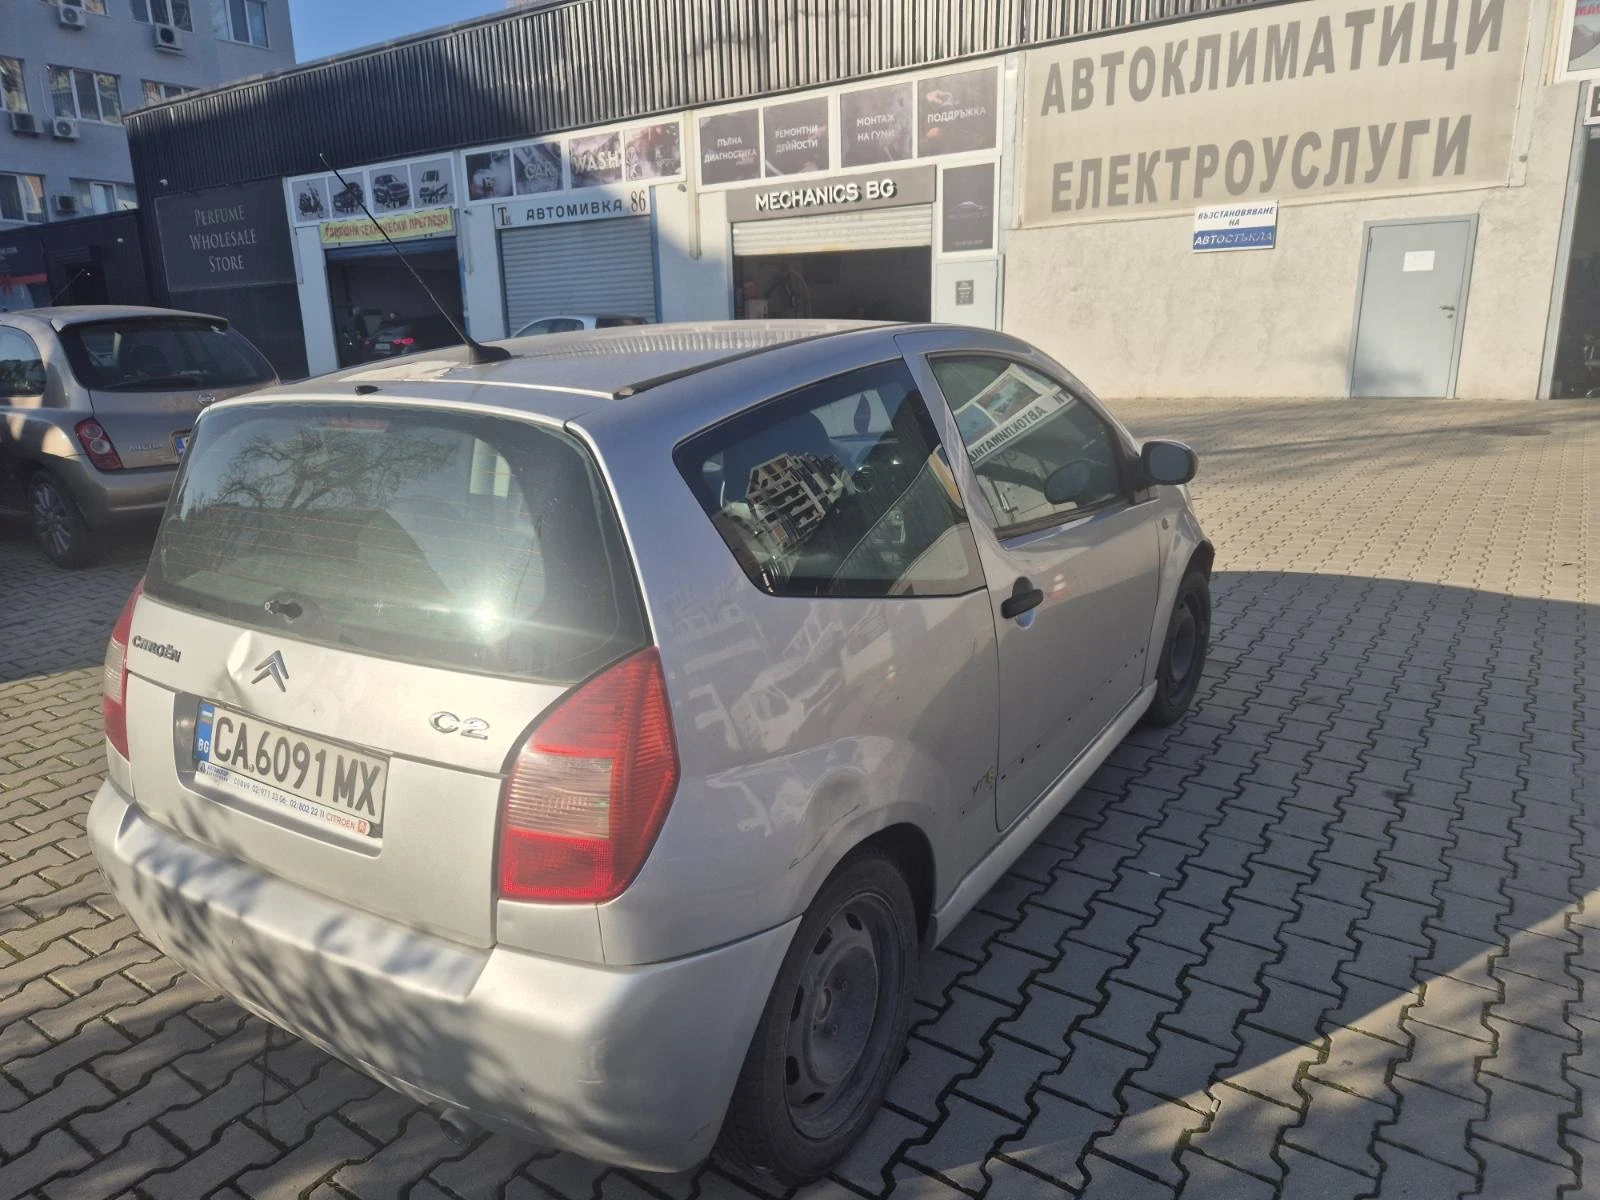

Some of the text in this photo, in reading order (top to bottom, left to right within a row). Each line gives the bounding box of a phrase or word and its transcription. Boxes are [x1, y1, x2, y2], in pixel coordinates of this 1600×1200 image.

[1040, 0, 1505, 117] АВТОКЛИМАТИЦИ
[857, 113, 895, 127] МОНТАЖ
[927, 105, 986, 124] ПОДДРЪЖКА
[775, 124, 819, 139] РЕМОНТНИ
[857, 133, 870, 142] НА
[717, 136, 743, 147] ПЪЛНА
[776, 138, 819, 154] ДЕЙНОСТИ
[524, 150, 620, 179] CAR WASH
[1051, 115, 1472, 213] ЕЛЕКТРОУСЛУГИ
[755, 179, 897, 211] MECHANICS BG
[526, 199, 623, 221] АВТОМИВКА
[630, 190, 646, 213] 86
[1198, 206, 1275, 220] ВЪЗСТАНОВЯВАНЕ
[1228, 218, 1240, 227] НА
[1194, 231, 1273, 246] АВТОСТЪКЛА
[428, 710, 491, 741] C2
[197, 737, 210, 754] BG
